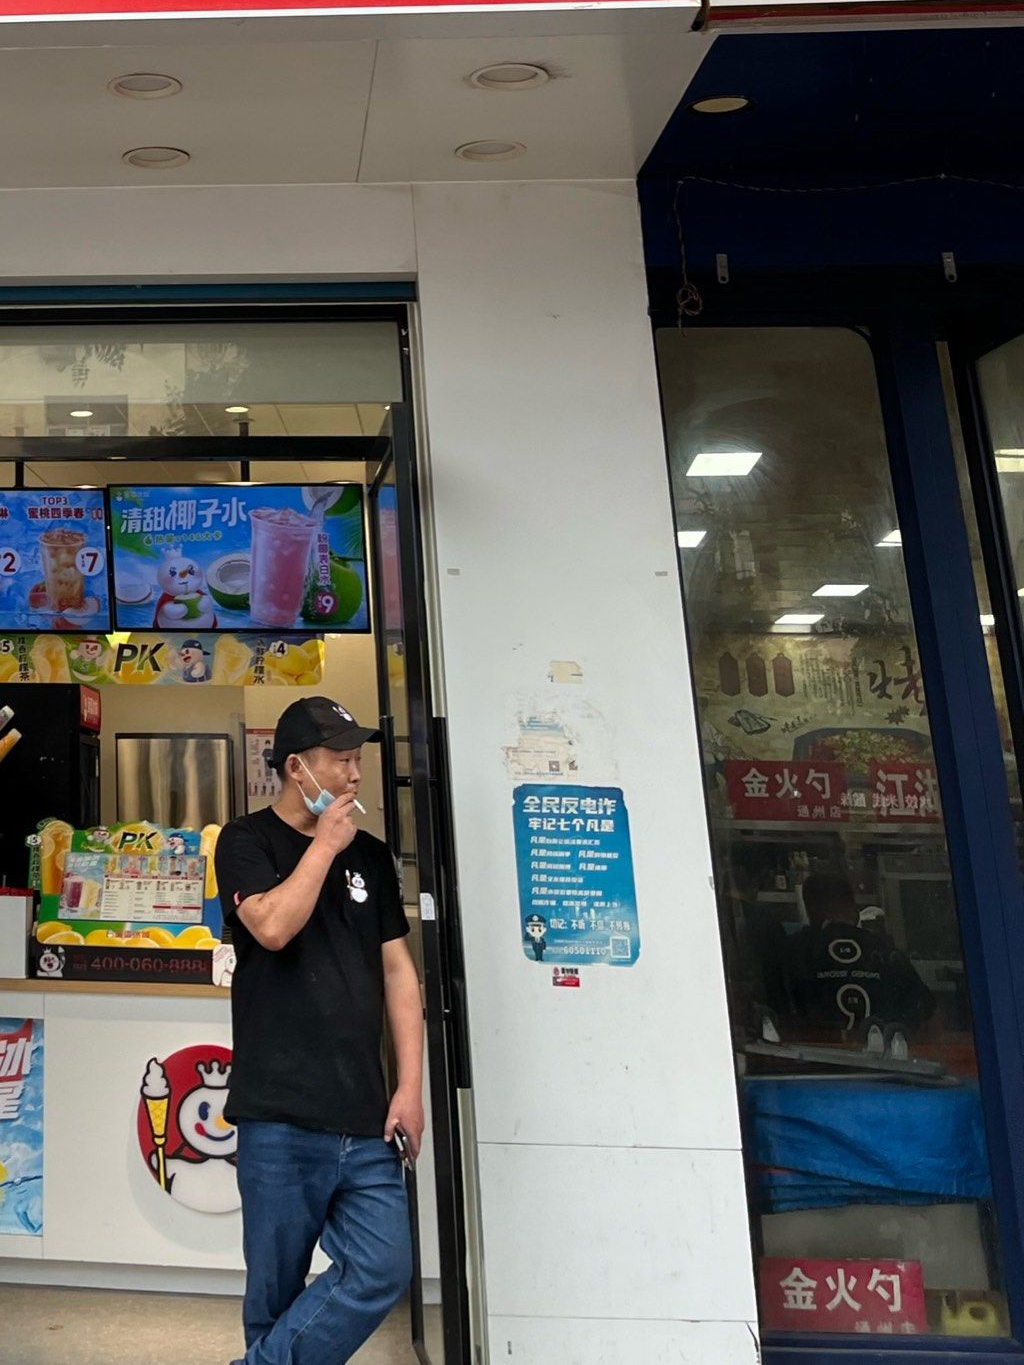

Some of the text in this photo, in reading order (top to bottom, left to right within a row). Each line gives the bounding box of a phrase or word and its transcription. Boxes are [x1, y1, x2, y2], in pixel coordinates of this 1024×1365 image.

[42, 497, 68, 505] TOP3
[120, 496, 247, 533] 清甜椰子水
[114, 643, 163, 673] PK
[741, 767, 831, 800] 金火勺
[522, 795, 617, 815] 全民反电诈
[528, 818, 615, 832] 牢记七个凡是
[118, 831, 158, 850] PK
[91, 956, 209, 973] 400-060-888
[779, 1266, 902, 1313] 金火勺
